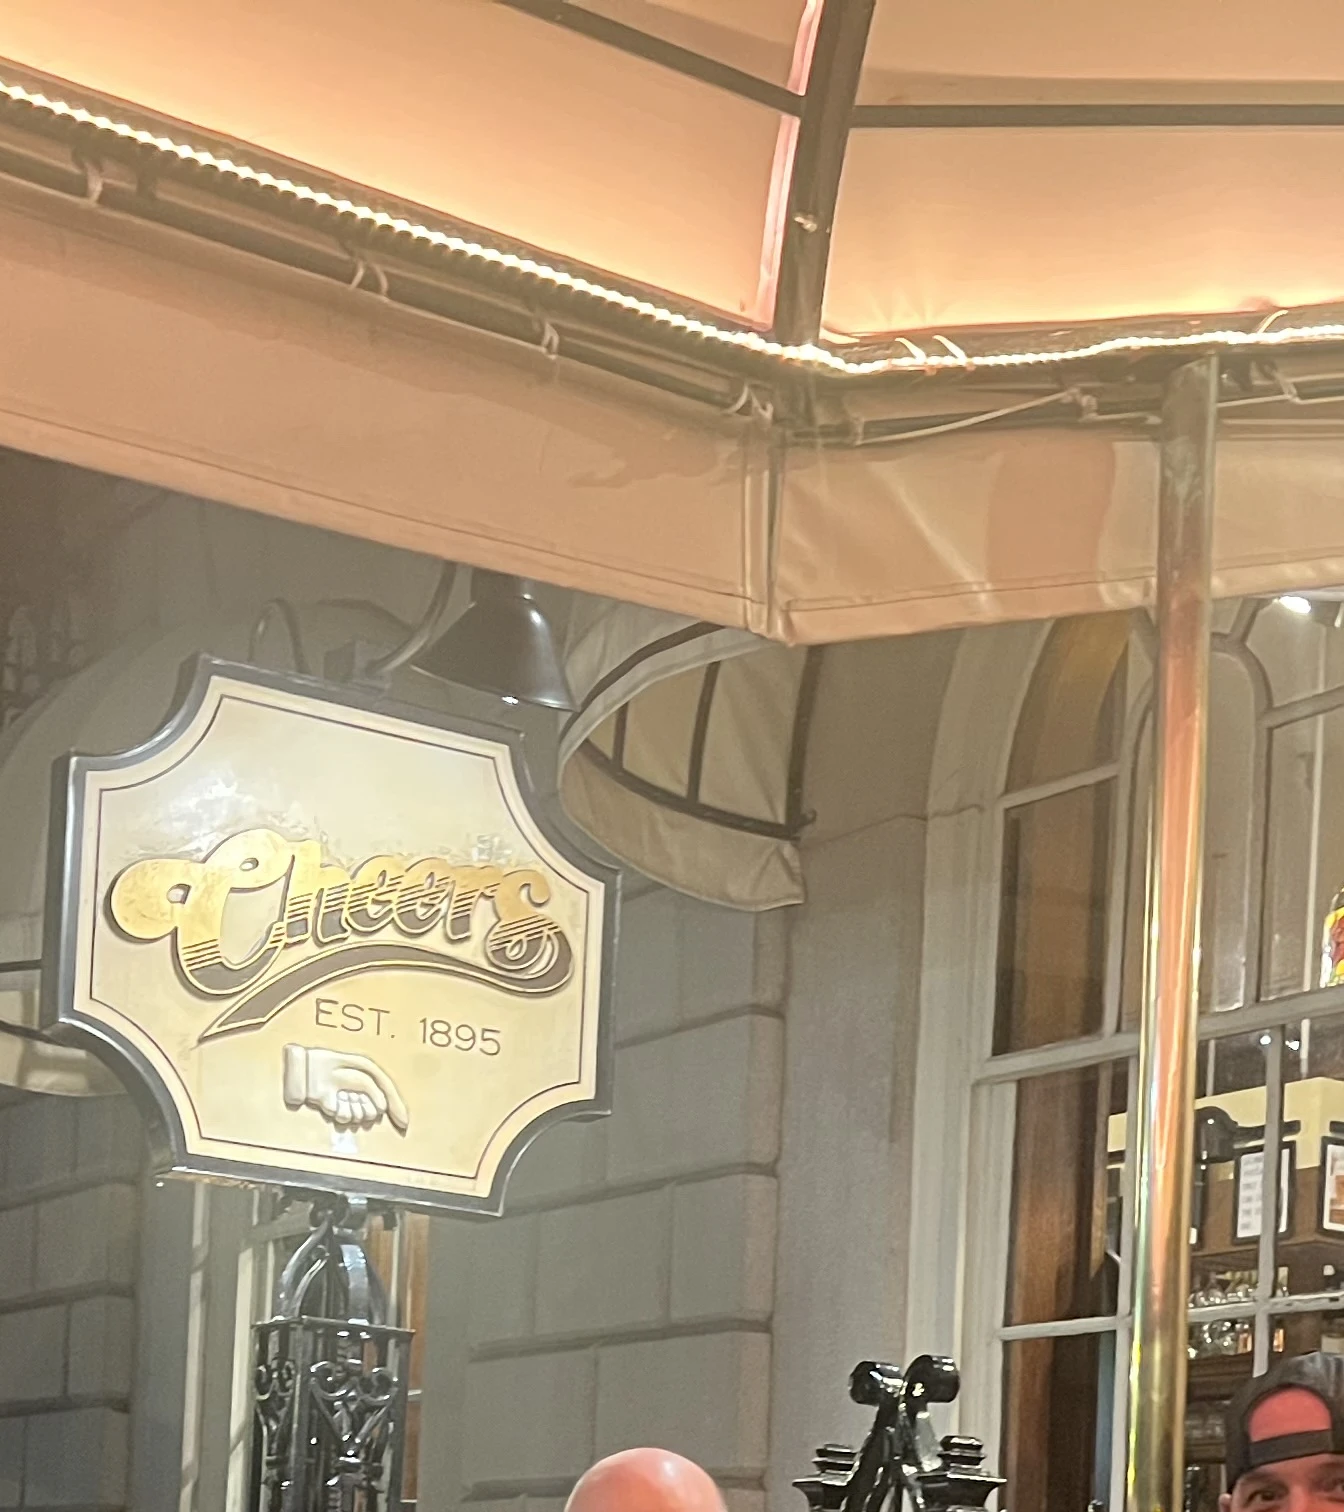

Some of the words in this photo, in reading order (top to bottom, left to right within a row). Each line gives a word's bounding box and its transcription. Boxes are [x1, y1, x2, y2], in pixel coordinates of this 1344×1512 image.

[110, 828, 574, 1043] Cheers
[315, 997, 396, 1039] EST.
[419, 1016, 502, 1057] 1895
